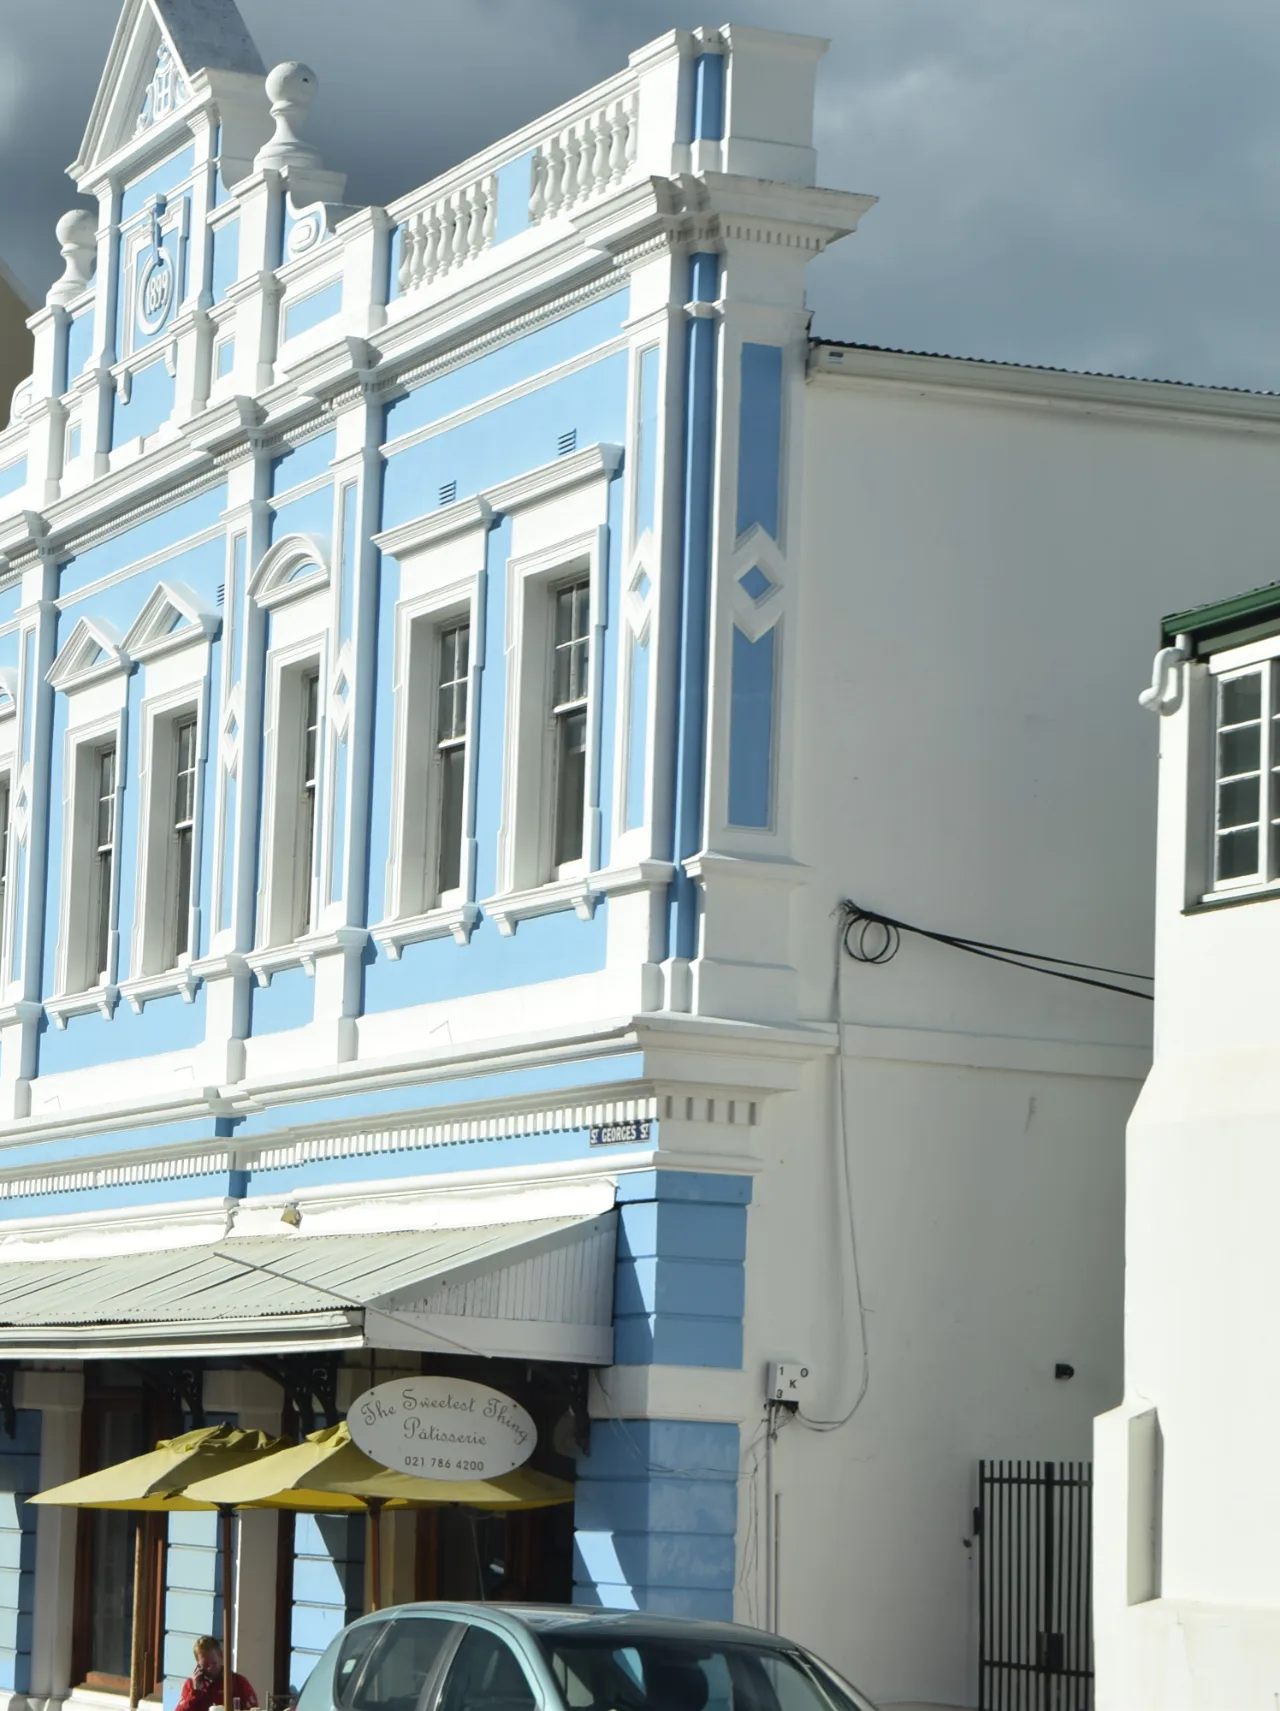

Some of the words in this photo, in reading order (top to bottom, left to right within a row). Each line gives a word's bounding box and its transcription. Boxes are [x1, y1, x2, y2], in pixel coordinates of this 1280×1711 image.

[145, 270, 168, 315] 1899
[602, 1126, 637, 1142] GEORGES
[780, 1366, 784, 1376] 1
[789, 1379, 797, 1389] K
[776, 1388, 783, 1399] 3
[361, 1400, 396, 1426] The
[402, 1388, 476, 1412] Sweetest
[482, 1397, 529, 1446] Thing
[404, 1456, 425, 1468] 021
[431, 1458, 451, 1469] 786
[455, 1460, 484, 1472] 4200
